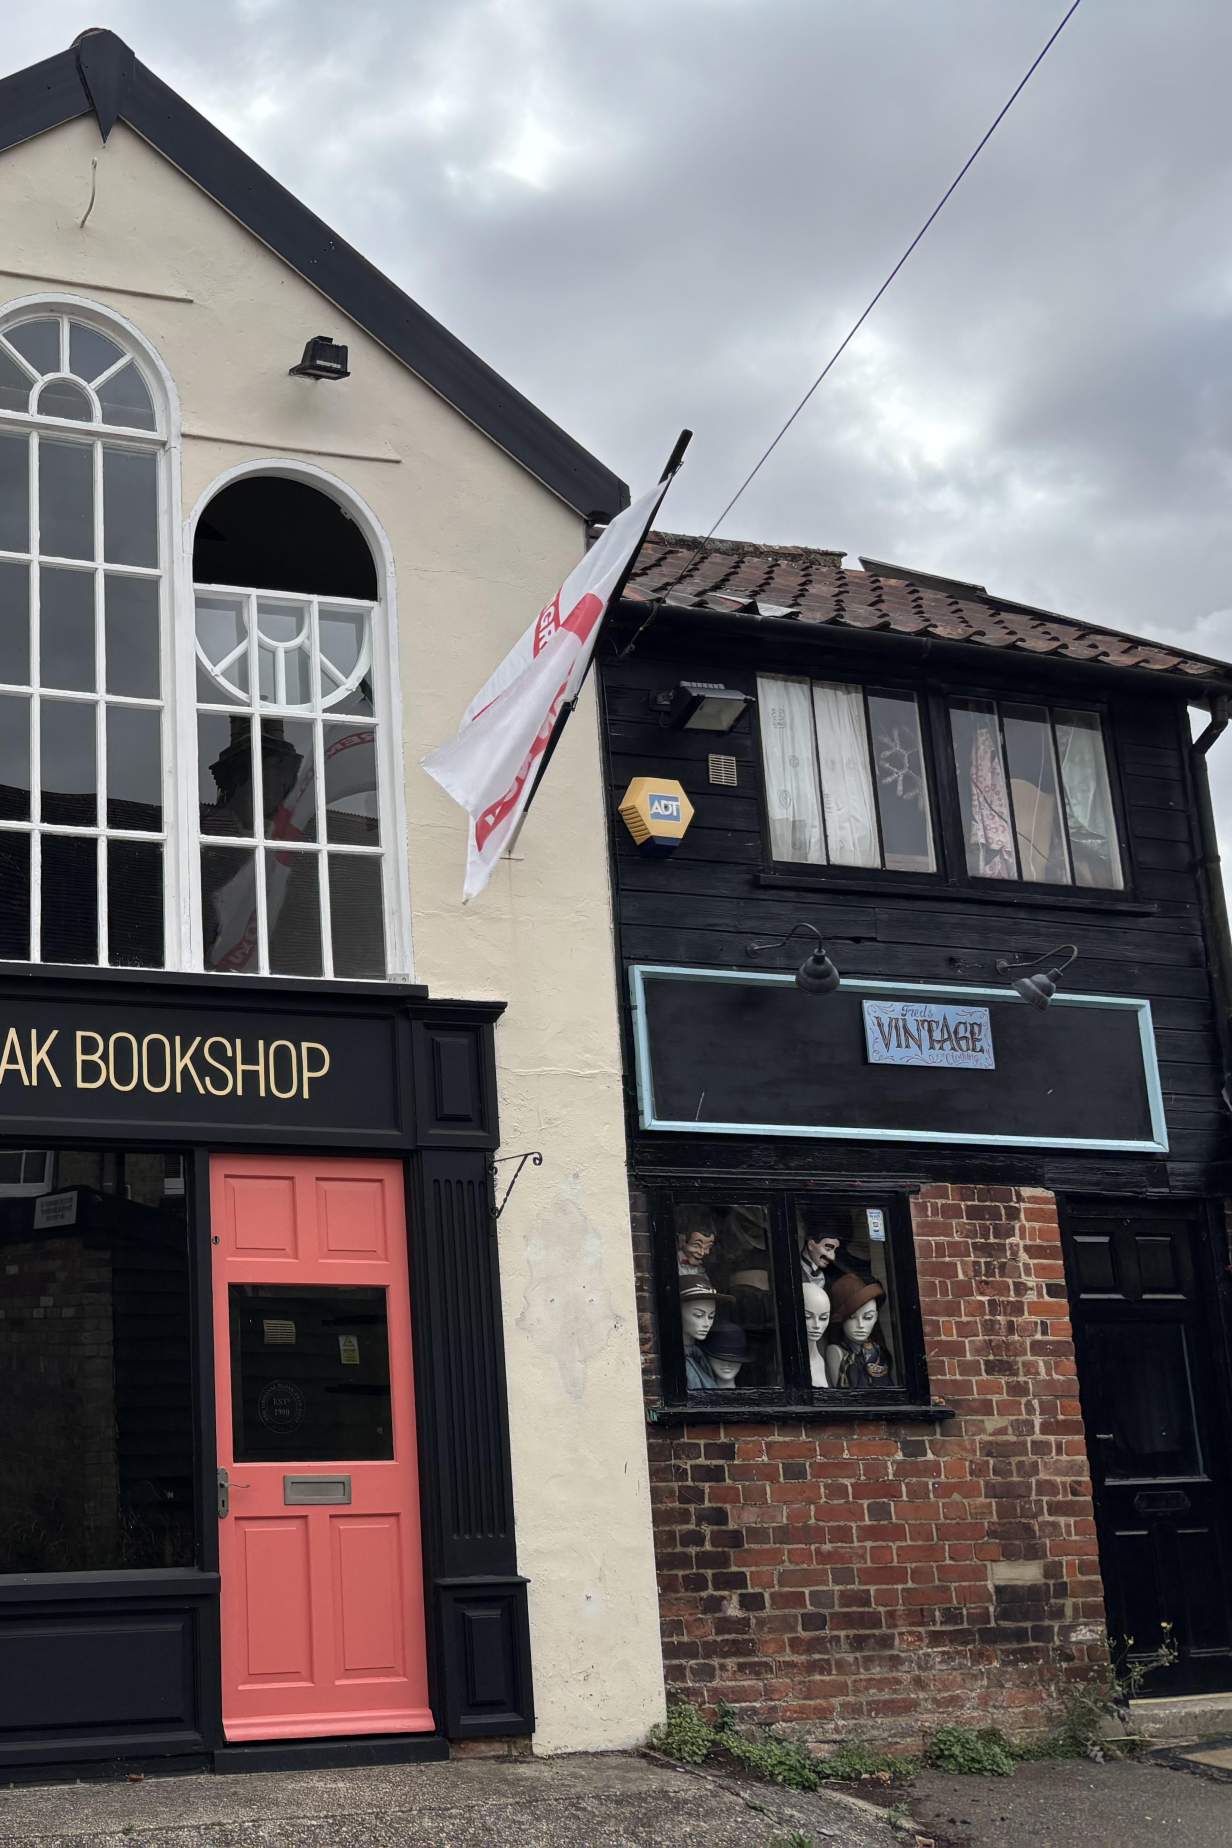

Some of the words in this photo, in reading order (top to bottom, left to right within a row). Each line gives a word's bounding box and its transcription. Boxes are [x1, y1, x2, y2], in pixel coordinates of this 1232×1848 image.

[650, 799, 681, 817] ADT
[873, 1012, 985, 1055] VINTAGE
[75, 1029, 331, 1100] BOOKSHOP
